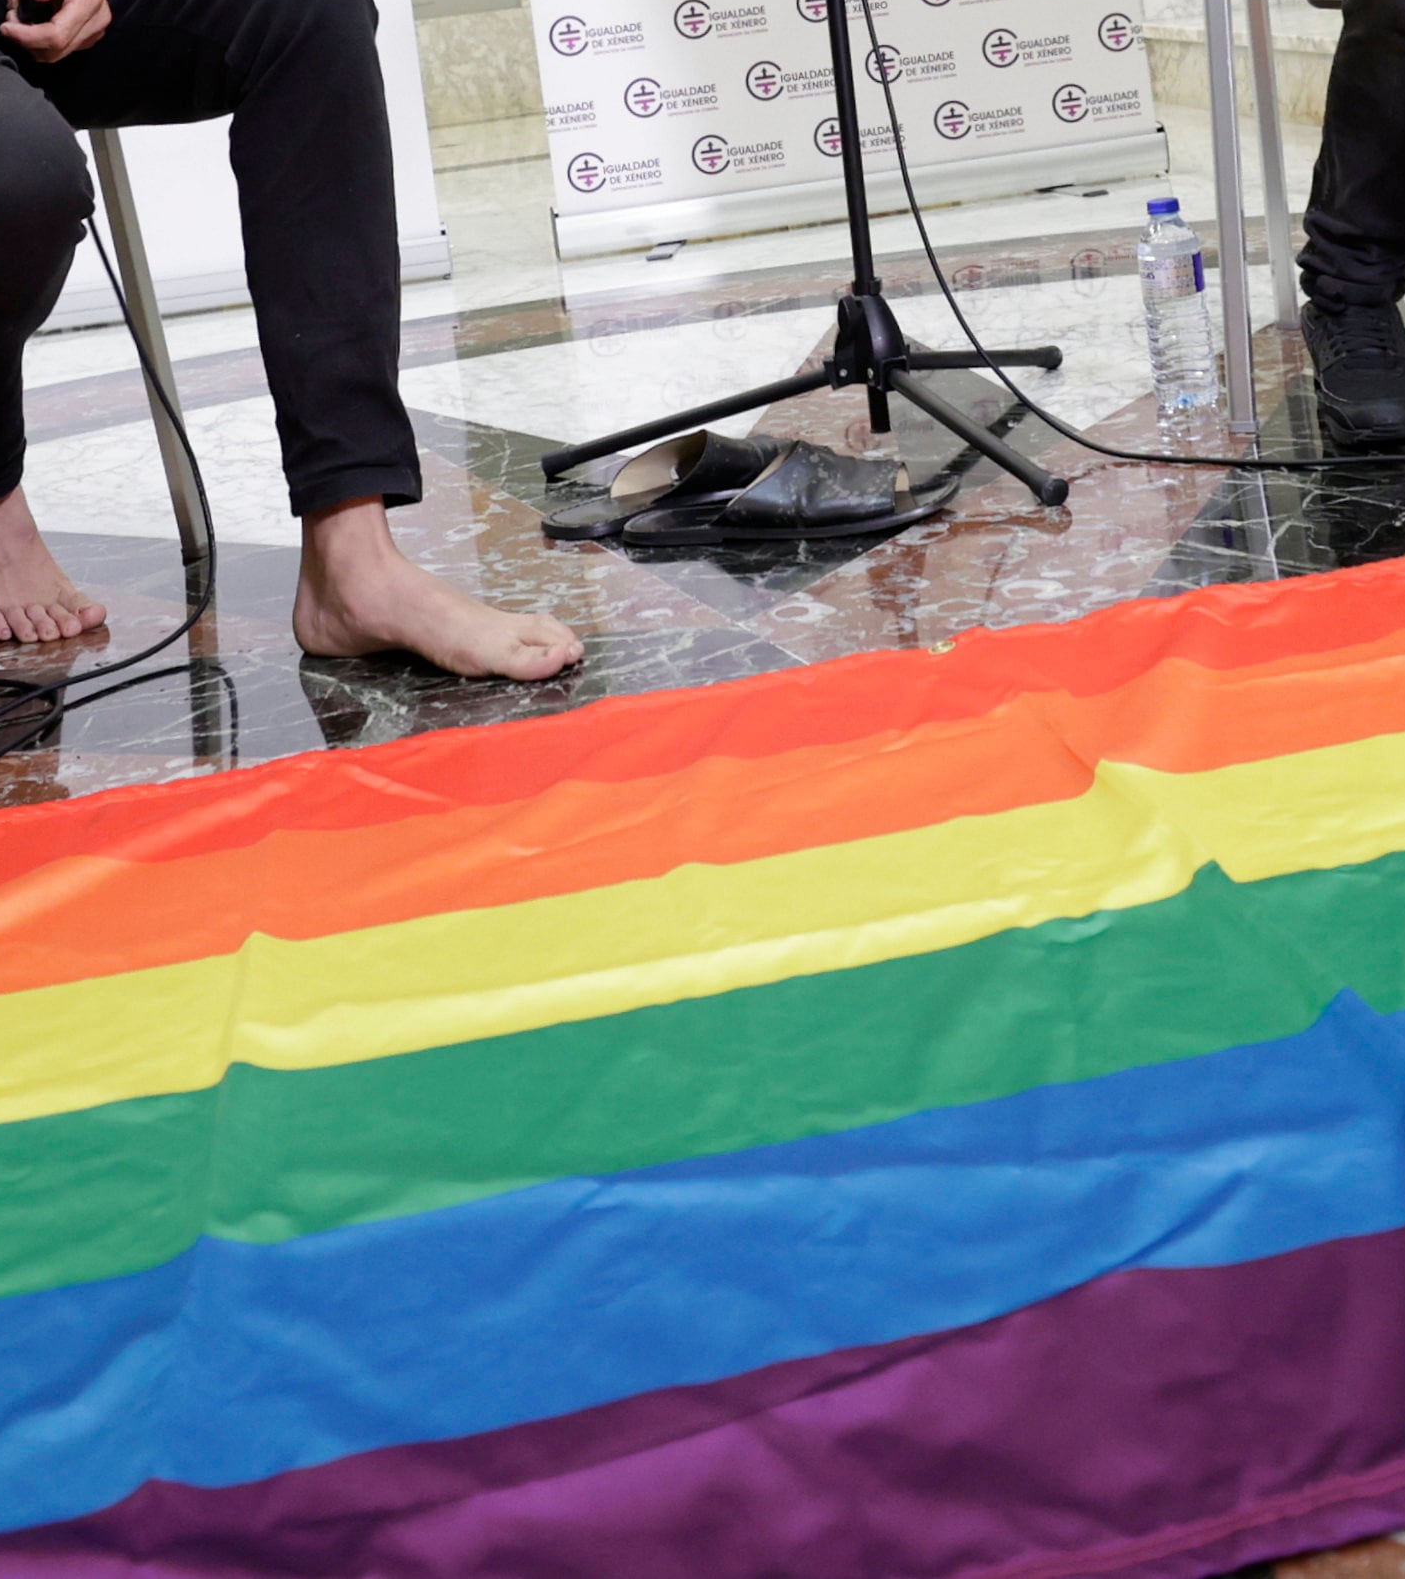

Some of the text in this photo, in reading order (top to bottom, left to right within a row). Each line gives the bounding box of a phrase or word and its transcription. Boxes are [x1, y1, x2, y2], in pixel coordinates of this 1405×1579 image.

[708, 5, 765, 20] IGUALDADE
[585, 22, 642, 37] IGUALDADE
[1016, 35, 1070, 49] IGUALDADE
[899, 50, 954, 66] IGUALDADE
[659, 83, 716, 99] IGUALDADE
[1085, 89, 1139, 104] IGUALDADE
[968, 106, 1022, 121] IGUALDADE
[726, 140, 783, 156] IGUALDADE
[602, 158, 660, 174] IGUALDADE
